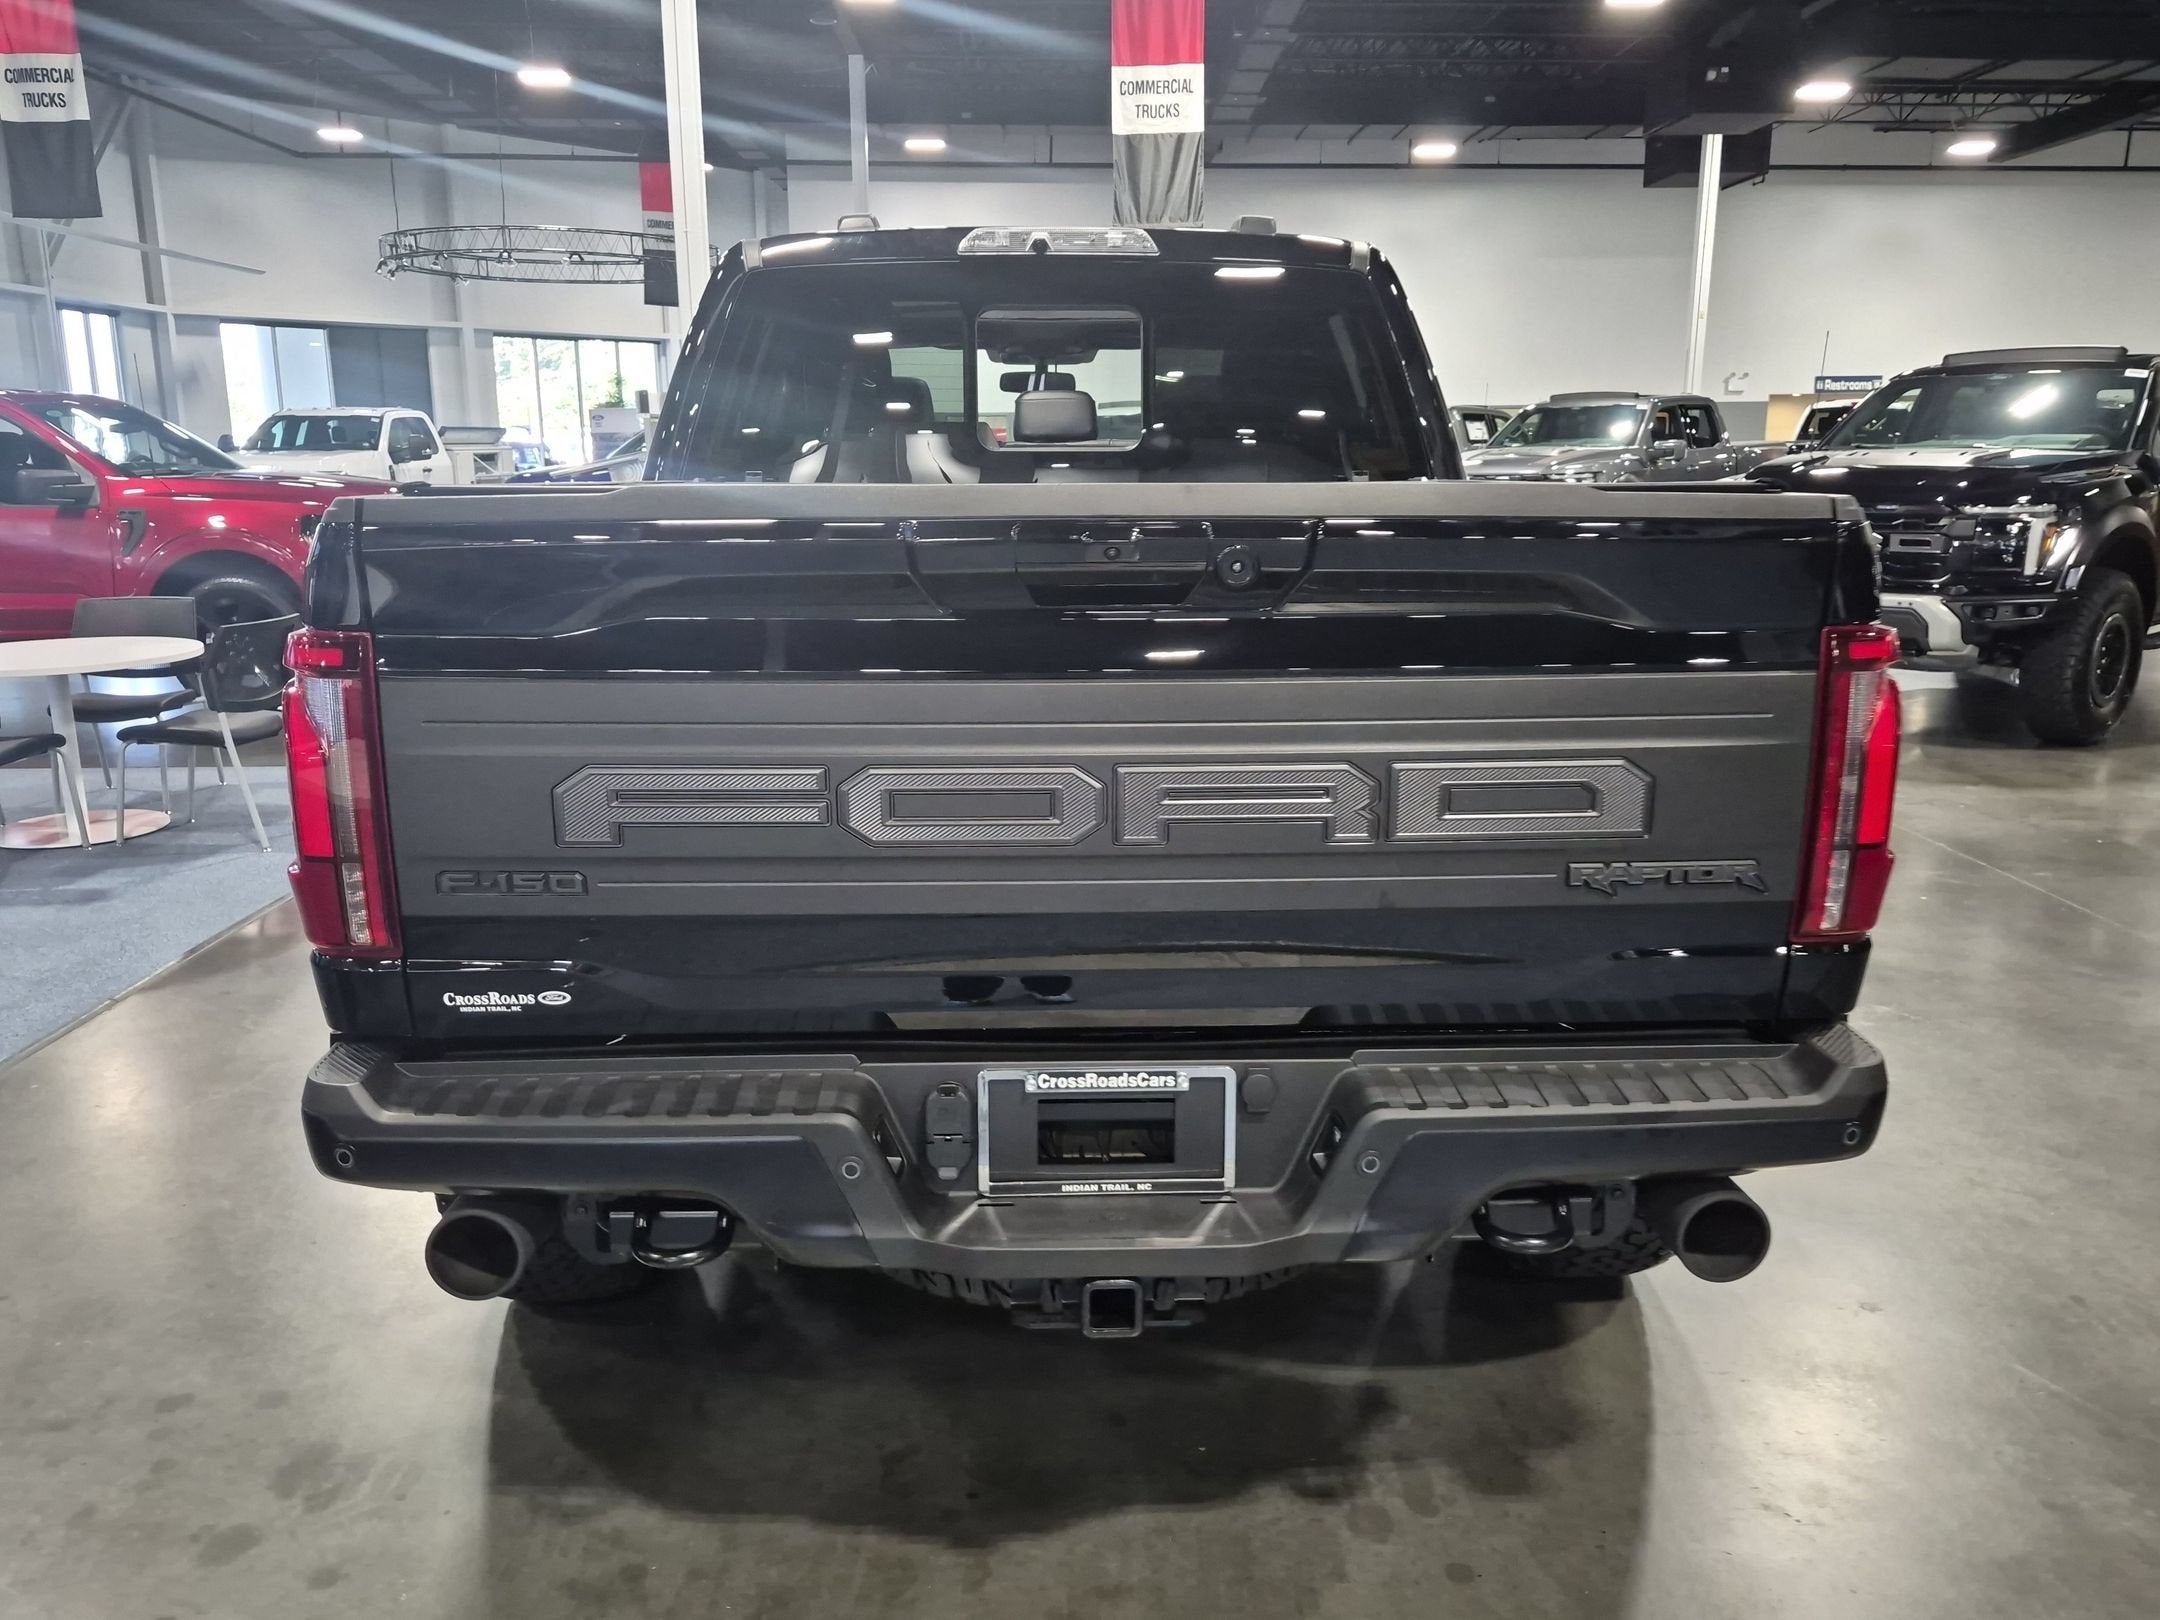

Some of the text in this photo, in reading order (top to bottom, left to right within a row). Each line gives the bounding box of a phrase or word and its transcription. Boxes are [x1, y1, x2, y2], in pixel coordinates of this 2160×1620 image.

[1119, 78, 1195, 96] COMMERCIAL
[21, 92, 67, 108] TRUCKS
[1134, 102, 1181, 119] TRUCKS
[1824, 379, 1873, 391] Restrooms
[551, 756, 1655, 848] FORD
[436, 871, 588, 896] F-150
[1567, 859, 1769, 899] RAPTOR
[1037, 1072, 1176, 1089] CrossRoadsCars
[1061, 1184, 1099, 1192] INDIAN
[1136, 1183, 1153, 1191] NC
